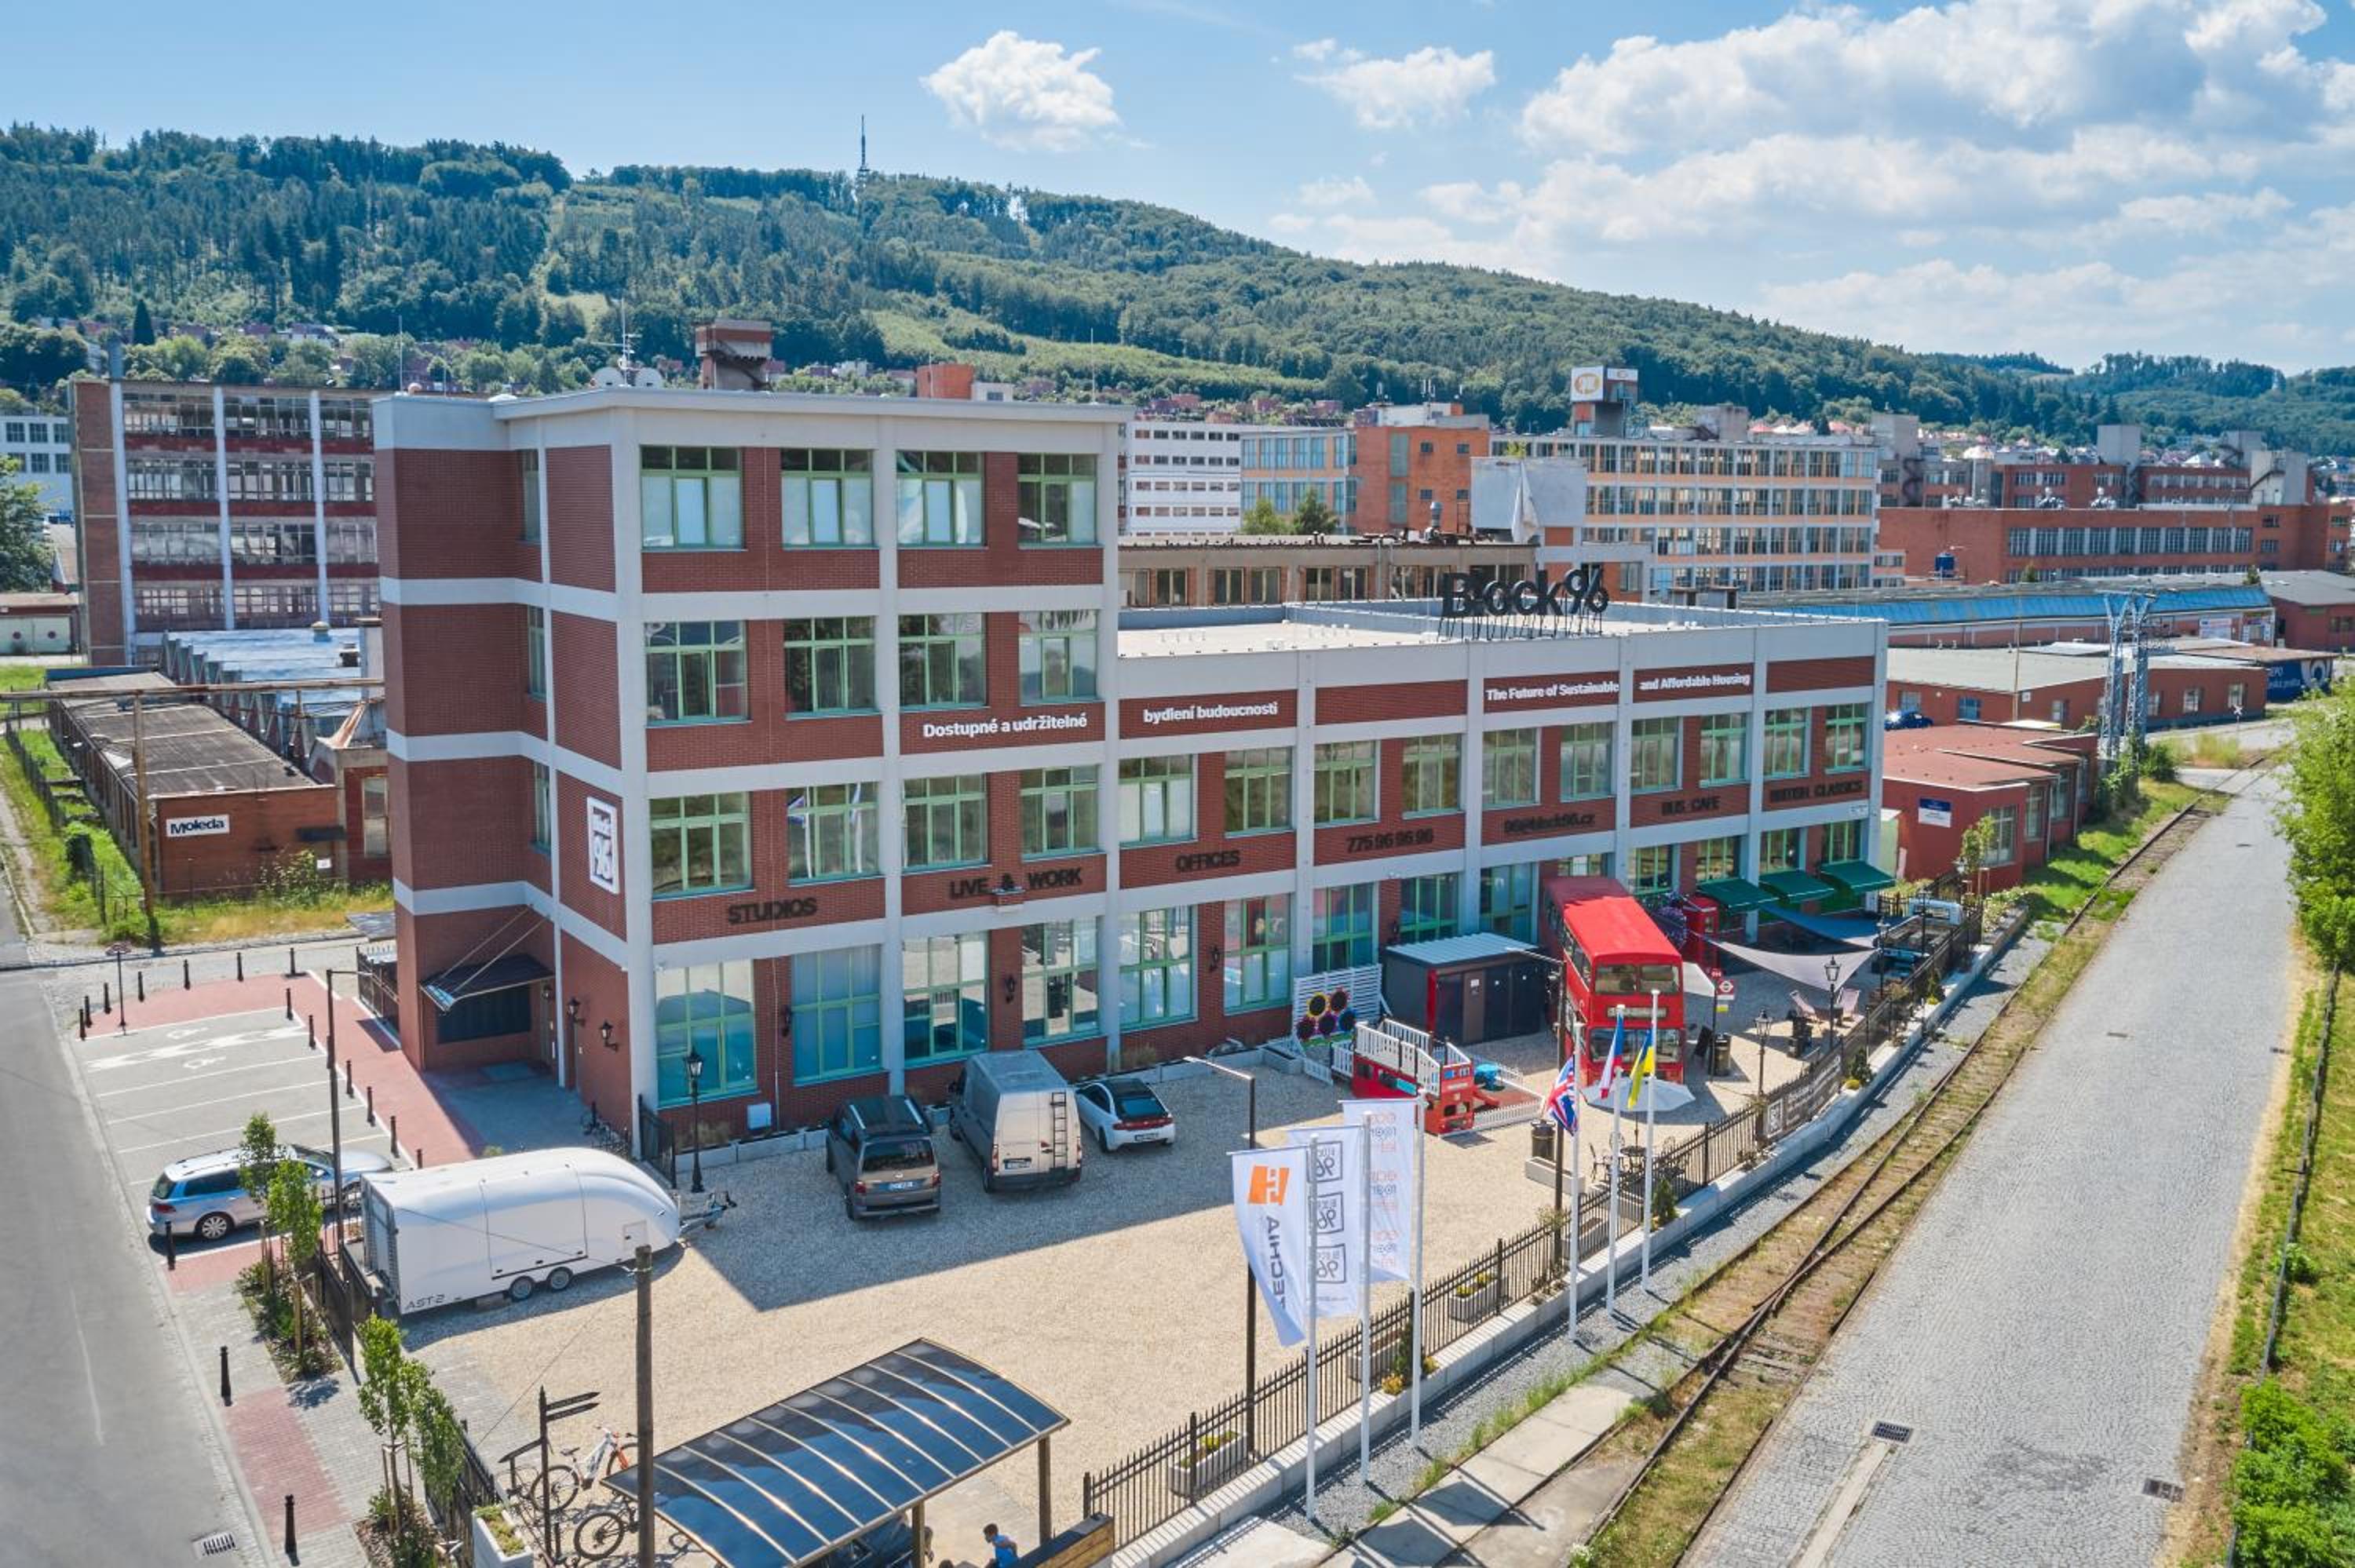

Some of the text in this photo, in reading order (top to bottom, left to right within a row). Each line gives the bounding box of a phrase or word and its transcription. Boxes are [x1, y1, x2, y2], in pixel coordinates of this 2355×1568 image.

[1486, 680, 1619, 701] The Future of Sustainable
[1639, 673, 1751, 691] and Affordable Housing
[1143, 702, 1278, 724] bydlení budoucnosti
[923, 713, 1087, 738] Dostupné a udržitelné
[1345, 834, 1373, 853] 775
[1175, 851, 1240, 873] OFFICES
[950, 877, 988, 899] LIVE
[1028, 867, 1083, 889] WORK
[728, 897, 817, 924] STUDIOS
